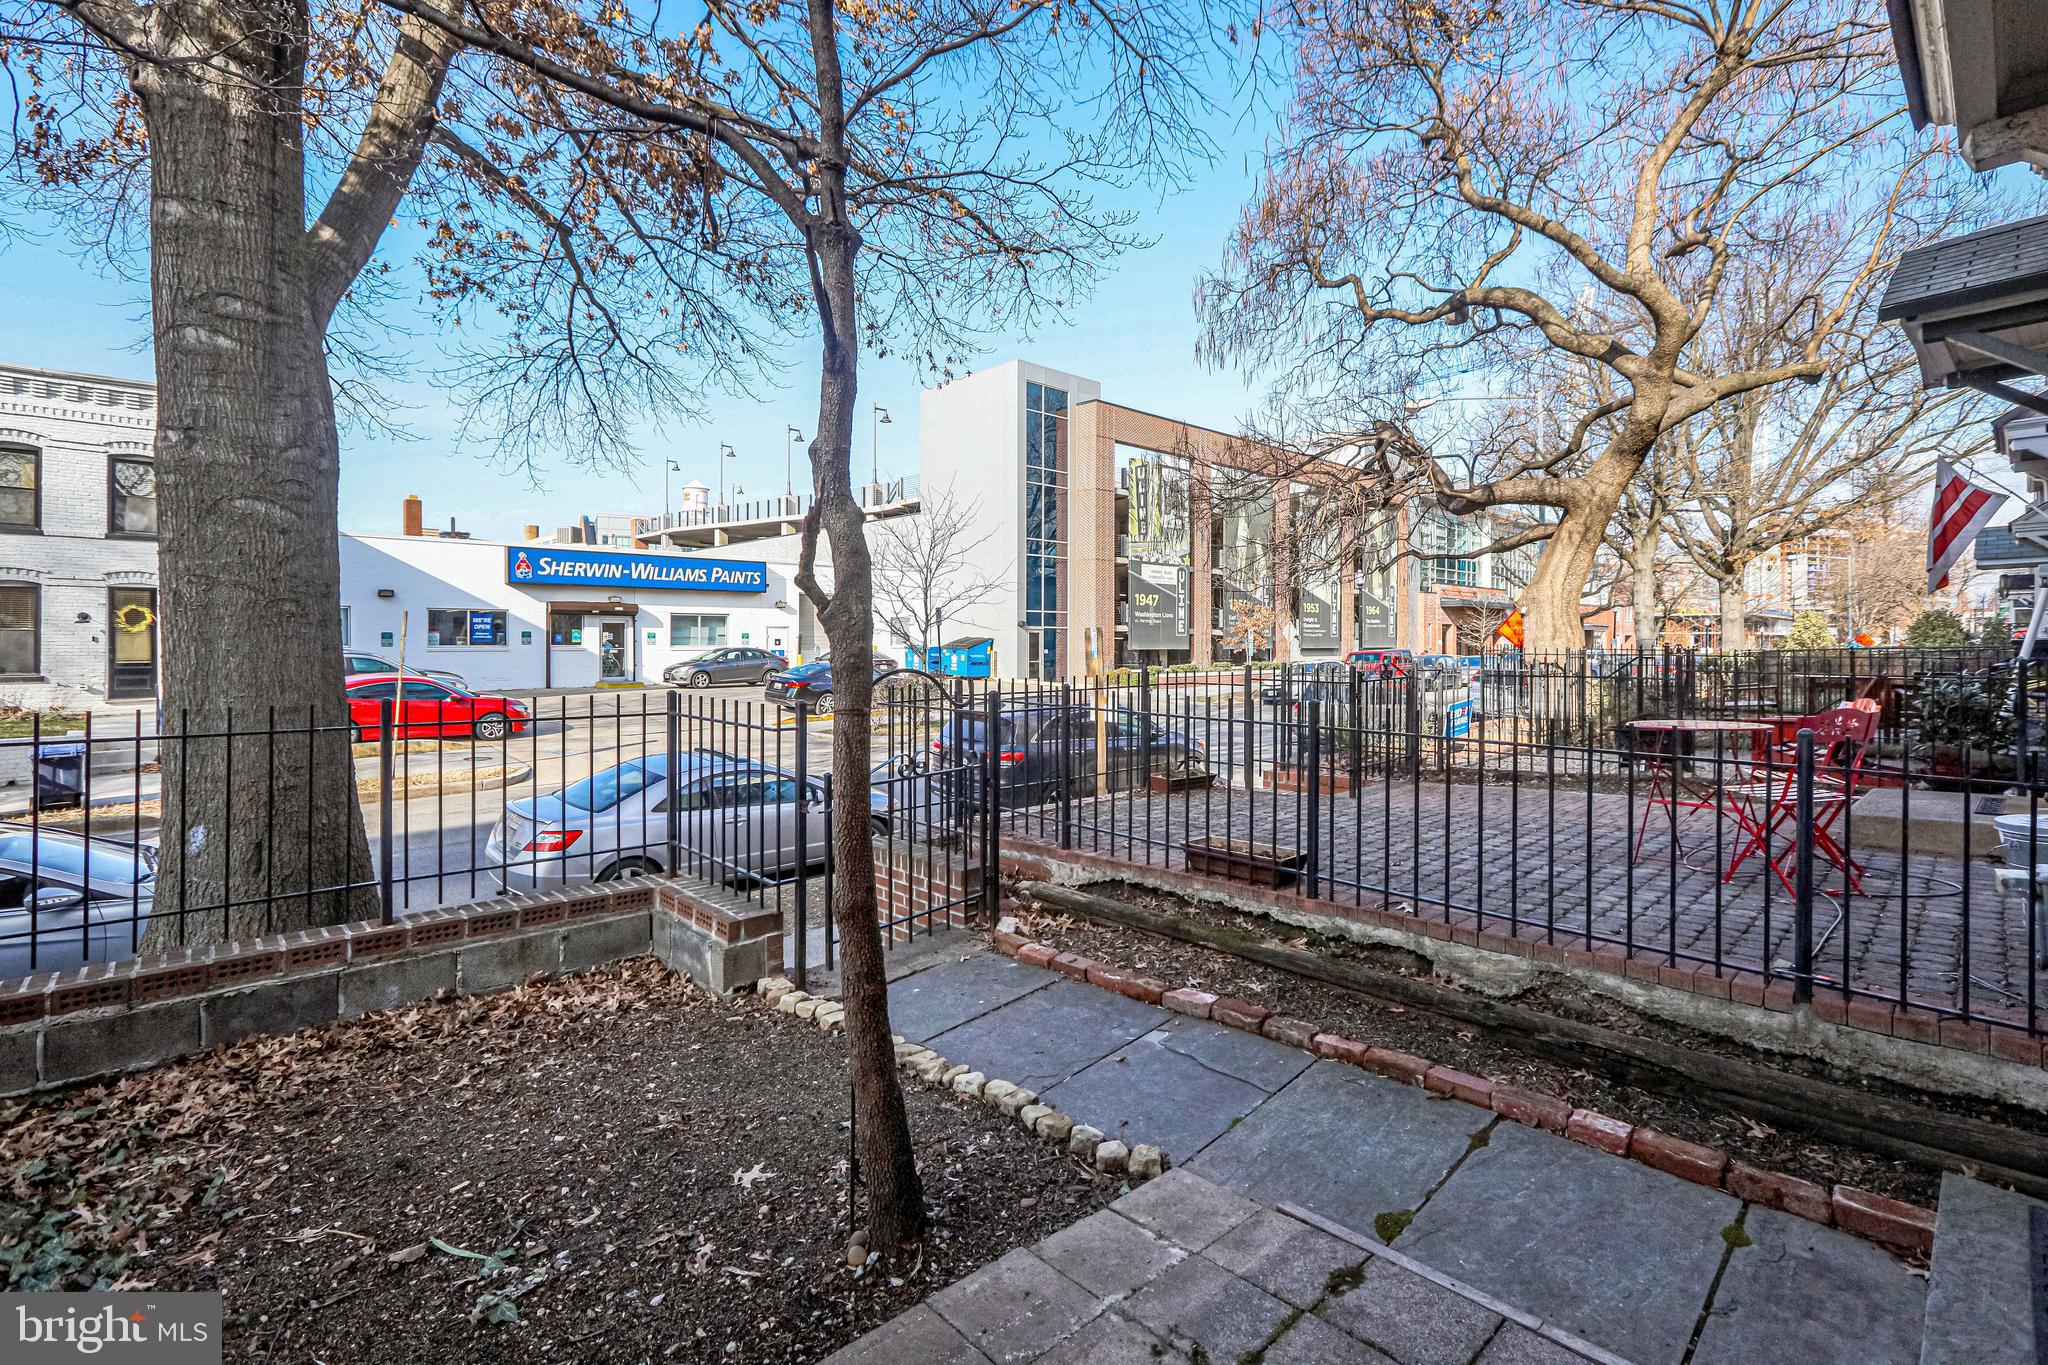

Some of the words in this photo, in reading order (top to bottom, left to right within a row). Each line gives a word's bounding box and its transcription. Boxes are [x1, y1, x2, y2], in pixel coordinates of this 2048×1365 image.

[1137, 466, 1146, 534] ULINE
[537, 557, 707, 583] SHERWIN-WILLIAMS
[710, 567, 761, 585] PAINTS
[1135, 593, 1159, 607] 1947
[1303, 602, 1320, 614] 1953
[1365, 605, 1380, 615] 1964
[1134, 611, 1161, 619] Washington
